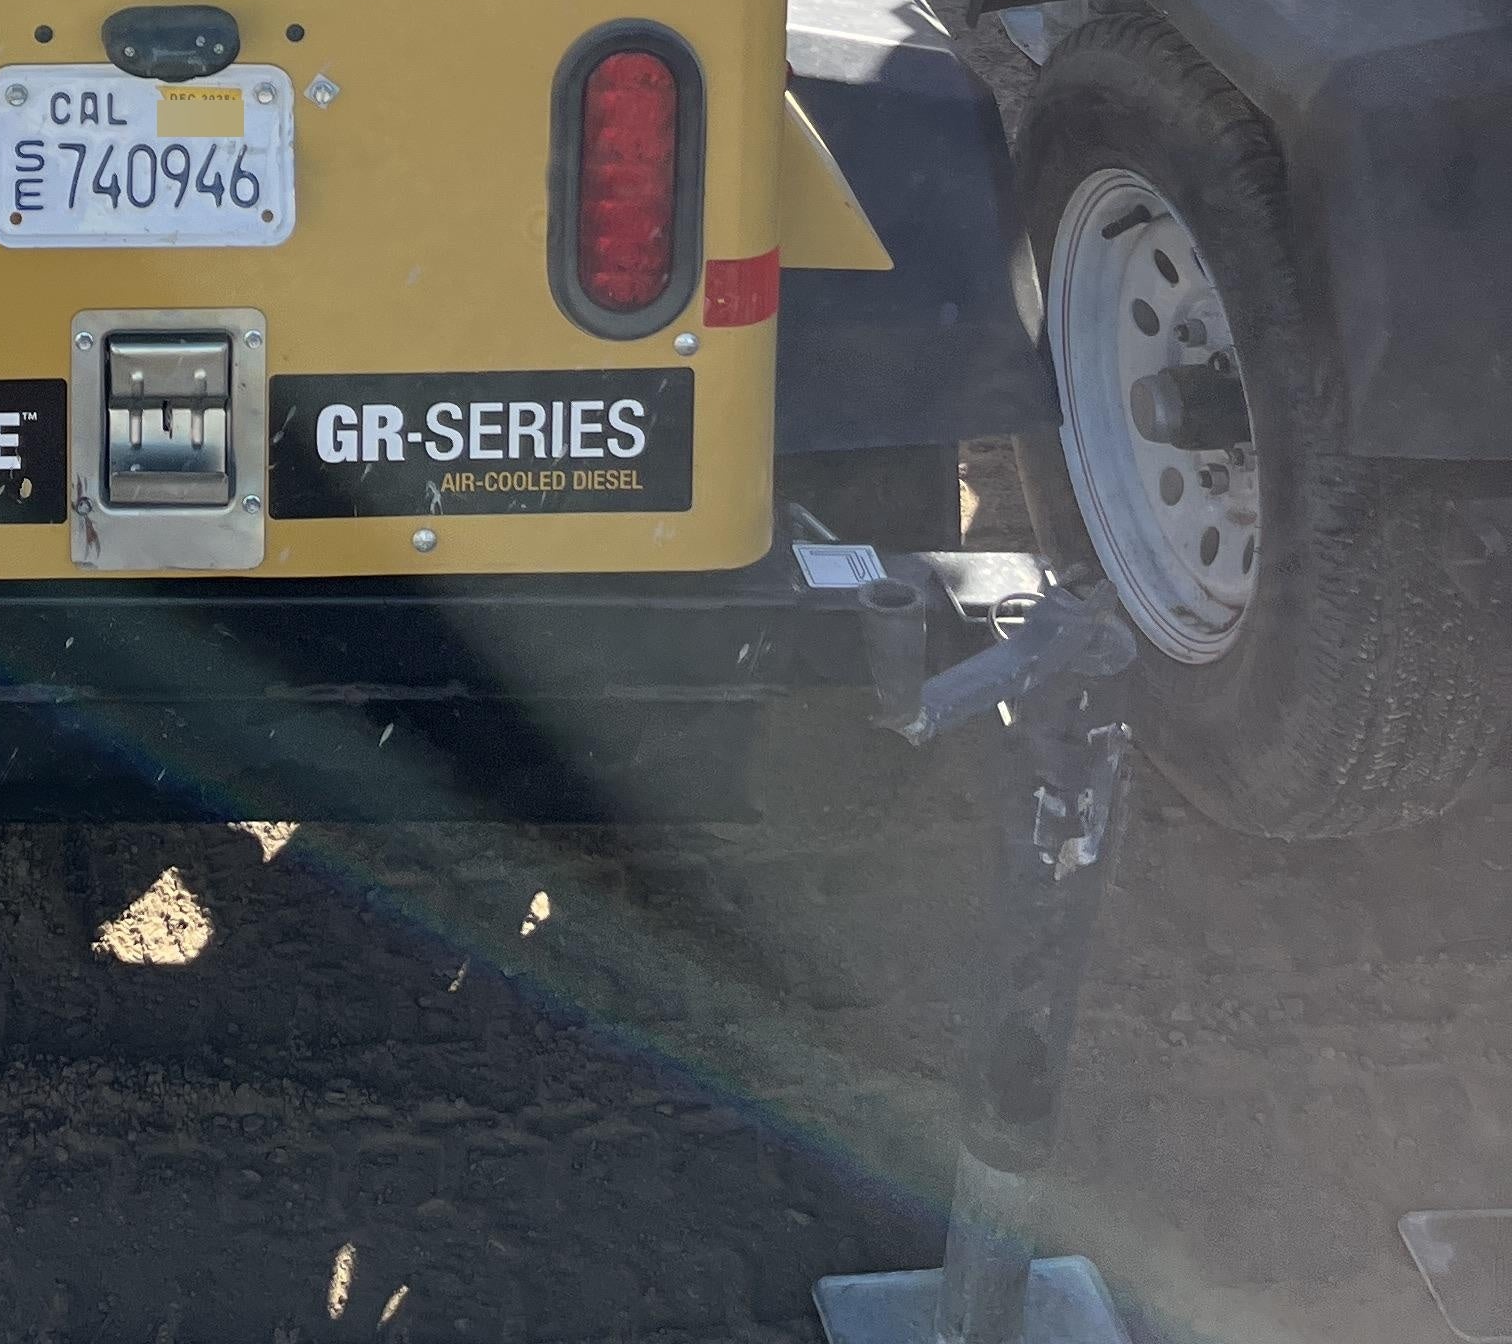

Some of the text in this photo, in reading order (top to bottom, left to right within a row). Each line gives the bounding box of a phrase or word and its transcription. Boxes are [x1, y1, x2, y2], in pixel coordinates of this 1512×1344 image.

[49, 91, 128, 126] CAL
[57, 143, 261, 209] 740946
[315, 398, 647, 464] GR-SERIES
[440, 469, 644, 493] AIR-COOLED DIESEL
